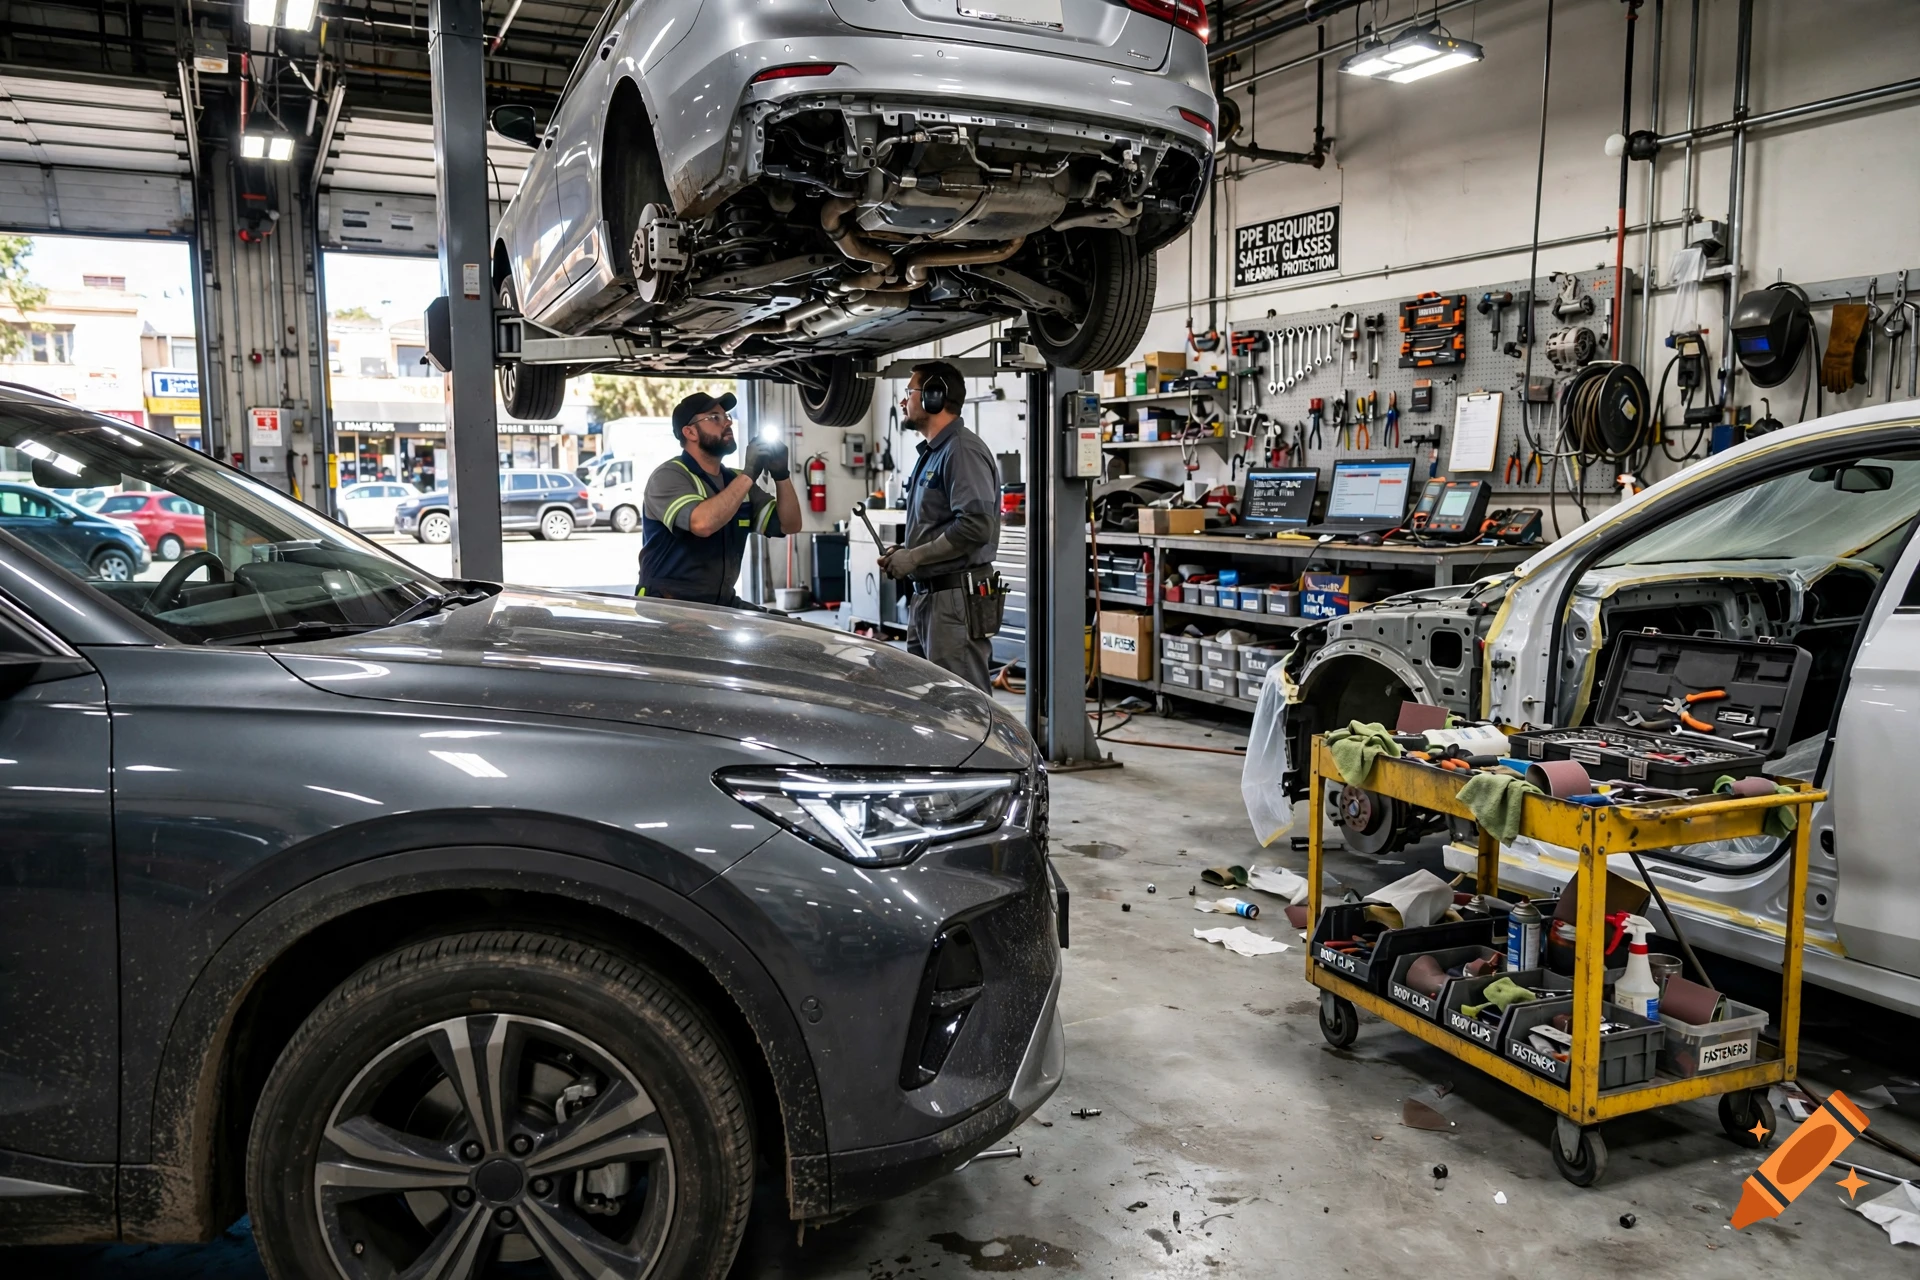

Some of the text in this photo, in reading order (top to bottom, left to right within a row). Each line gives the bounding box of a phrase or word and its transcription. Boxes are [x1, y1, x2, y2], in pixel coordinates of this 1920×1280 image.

[1239, 211, 1335, 250] PPE REQUIRED
[1239, 234, 1332, 268] SAFETY GLASSES
[1281, 253, 1335, 276] PROTECTION
[1394, 985, 1410, 1001] BODY
